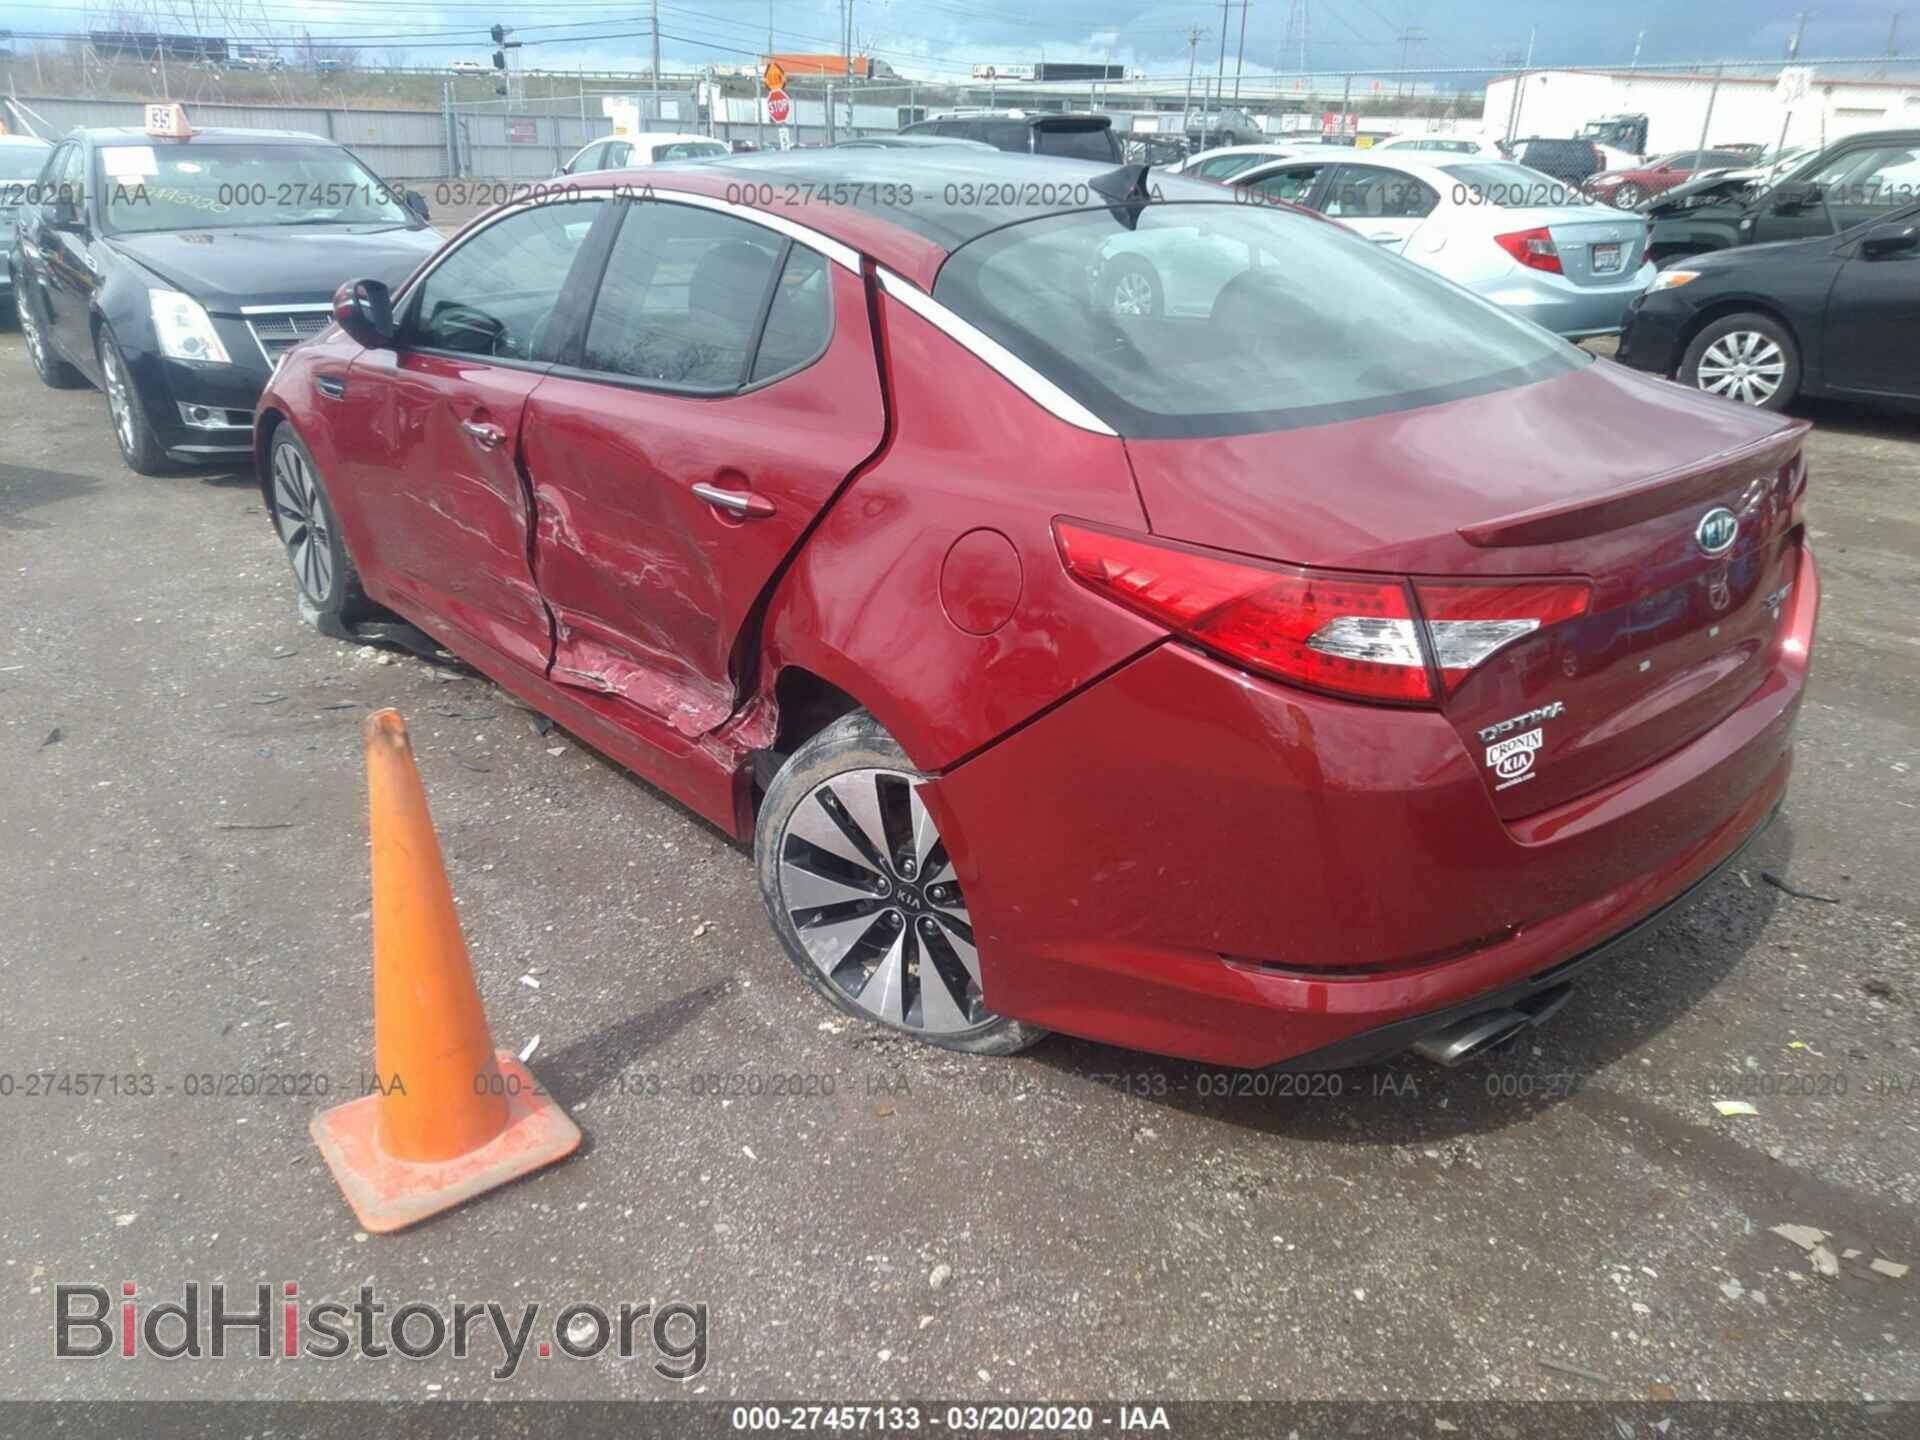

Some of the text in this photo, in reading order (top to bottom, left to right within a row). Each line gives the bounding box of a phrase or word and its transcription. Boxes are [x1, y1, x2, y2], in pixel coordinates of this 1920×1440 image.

[768, 99, 789, 113] STOP
[1478, 701, 1566, 741] OPTIMA
[1489, 731, 1541, 763] CRONIN
[1503, 754, 1528, 773] KIA
[897, 889, 921, 910] KIA
